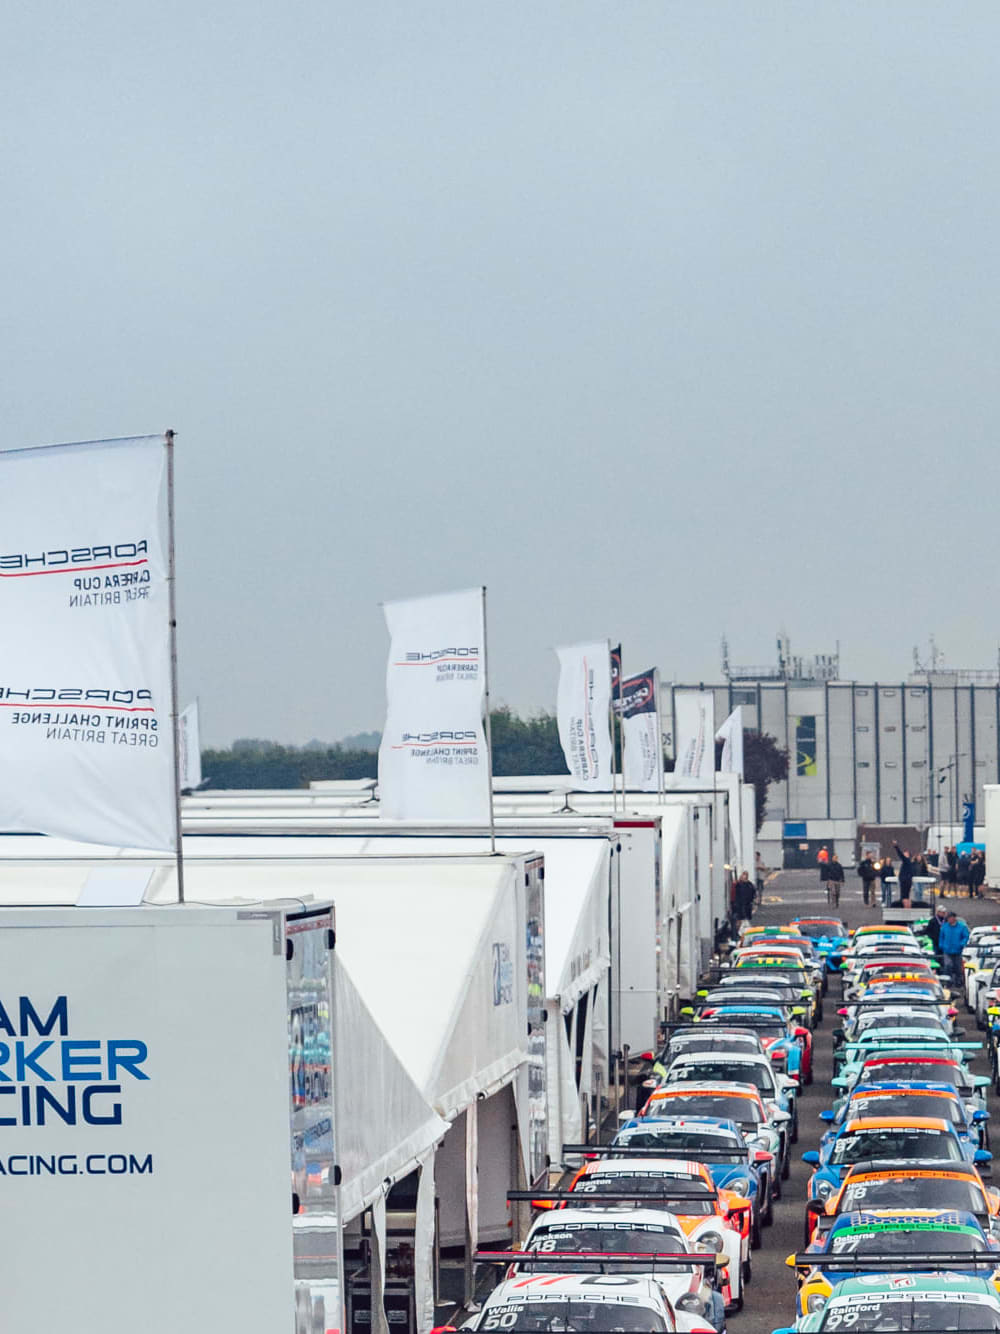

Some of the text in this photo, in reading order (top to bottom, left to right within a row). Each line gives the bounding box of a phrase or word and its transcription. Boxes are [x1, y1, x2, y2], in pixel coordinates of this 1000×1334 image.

[0, 1040, 150, 1082] KER
[590, 1172, 693, 1180] PORSCHE
[865, 1171, 959, 1179] PORSCHE
[549, 1223, 664, 1232] PORSCHE
[853, 1224, 961, 1232] PORSCHE
[532, 1233, 573, 1242] Jackson
[507, 1295, 640, 1303] PORSCHE
[849, 1293, 980, 1302] PORSCHE
[488, 1305, 524, 1315] Wallis
[830, 1303, 880, 1316] Rainford
[485, 1314, 518, 1330] 50
[827, 1313, 860, 1330] 99
